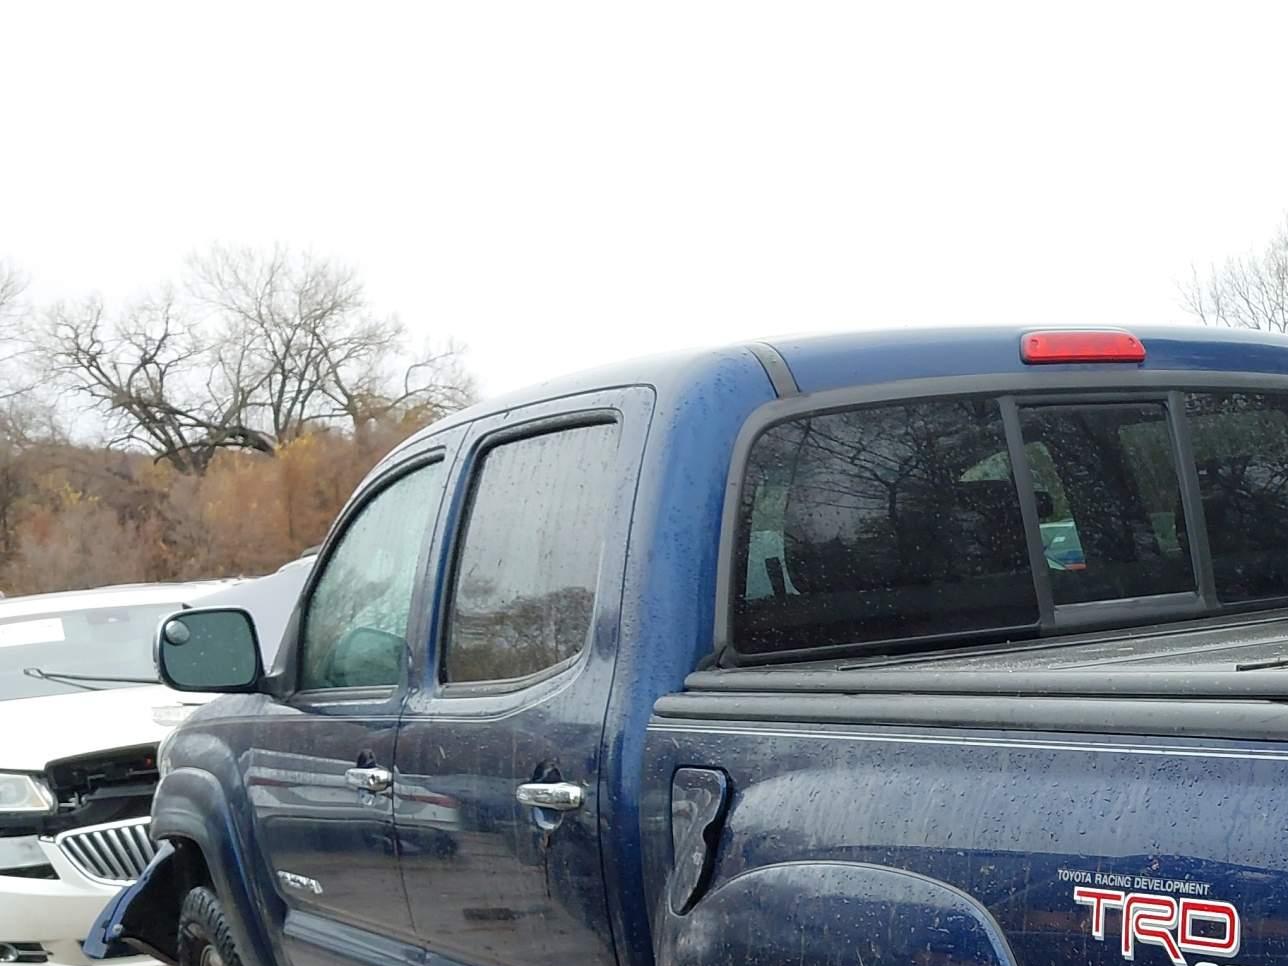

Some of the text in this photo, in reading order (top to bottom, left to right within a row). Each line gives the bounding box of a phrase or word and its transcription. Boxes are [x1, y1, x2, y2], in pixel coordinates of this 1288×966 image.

[1057, 869, 1210, 896] TOYOTA RACING DEVELOPMENT
